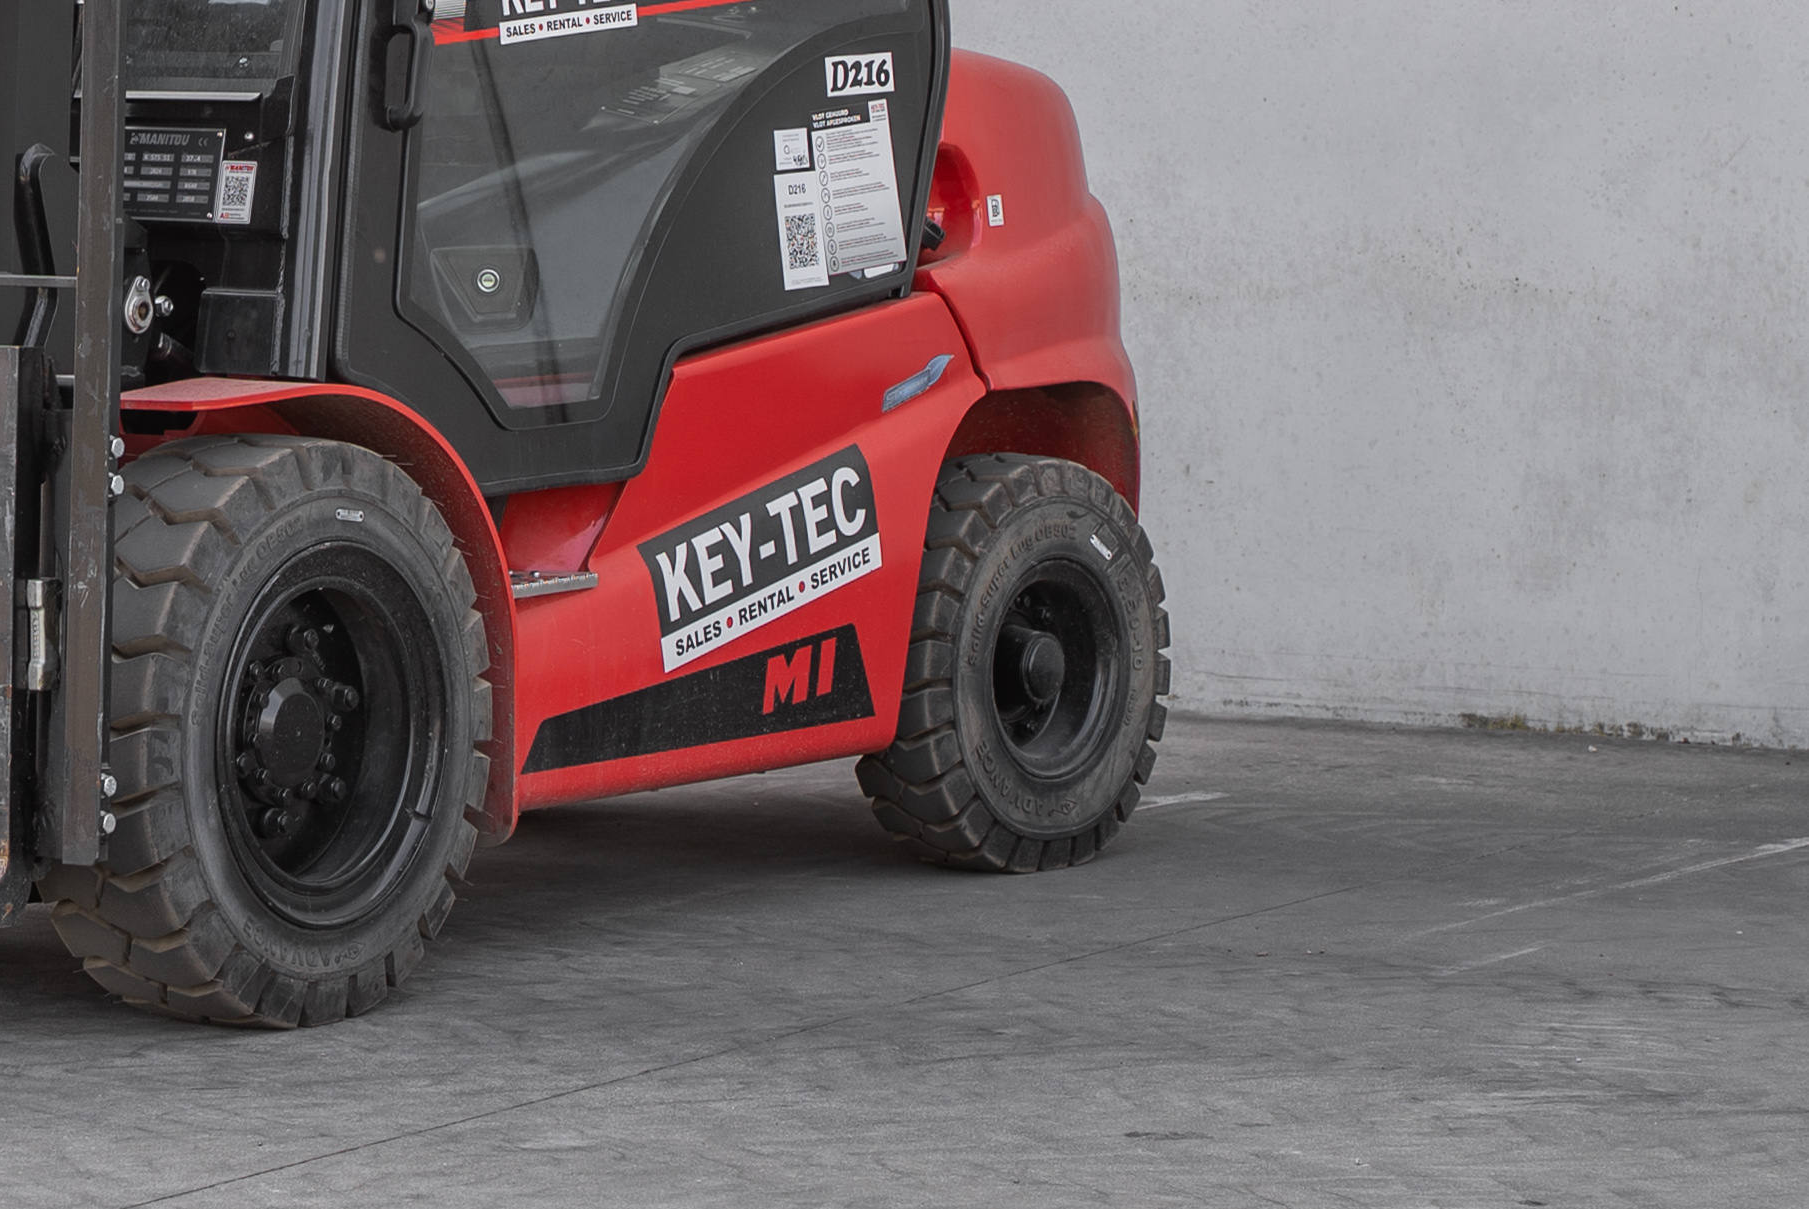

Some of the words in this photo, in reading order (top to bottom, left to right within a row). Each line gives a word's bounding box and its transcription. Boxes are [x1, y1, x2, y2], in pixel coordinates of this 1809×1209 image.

[506, 23, 536, 38] SALES
[546, 16, 583, 32] RENTAL
[593, 10, 633, 25] SERVICE
[830, 58, 891, 93] D216
[139, 132, 190, 146] MANITOU
[787, 183, 807, 196] D216
[655, 466, 867, 623] KEY-TEC
[675, 620, 722, 657] SALES
[738, 585, 795, 626] RENTAL
[810, 546, 871, 590] SERVICE
[762, 636, 837, 716] MI
